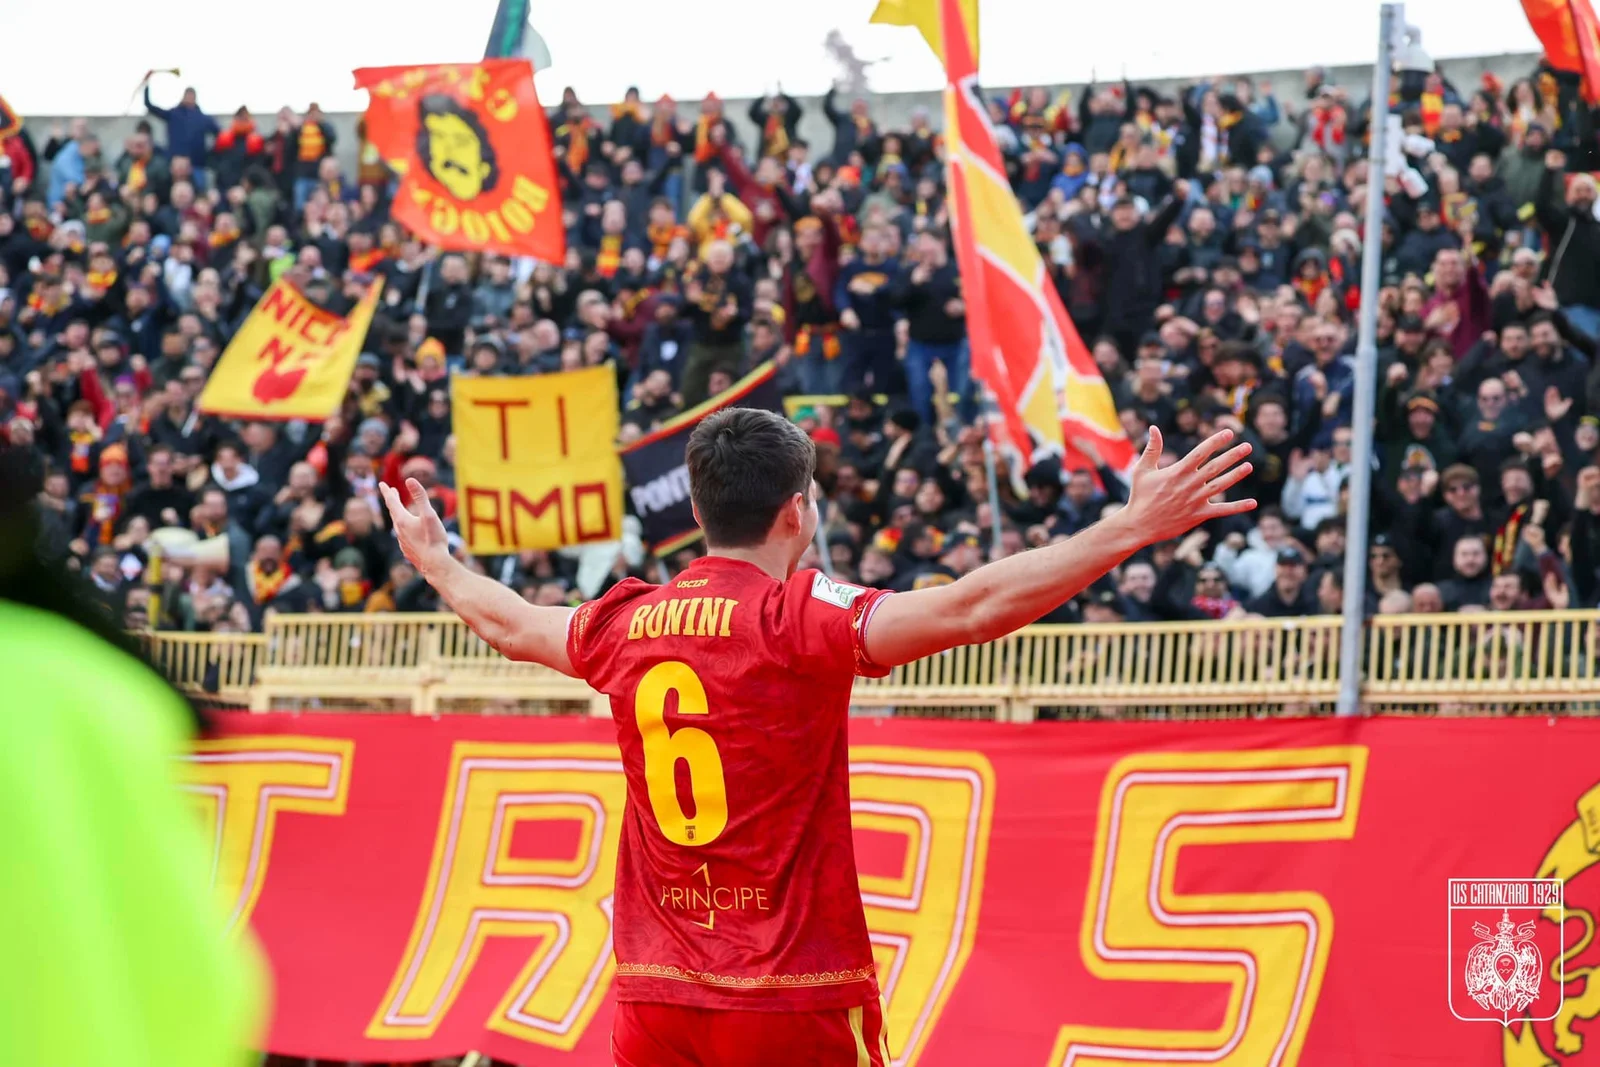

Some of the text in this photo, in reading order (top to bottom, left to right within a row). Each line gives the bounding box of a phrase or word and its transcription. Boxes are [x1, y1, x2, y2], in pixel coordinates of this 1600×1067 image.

[472, 395, 569, 460] TI
[465, 481, 612, 547] AMO
[627, 597, 739, 641] BONINI
[634, 660, 728, 847] 6
[660, 884, 770, 911] PRINCIPE
